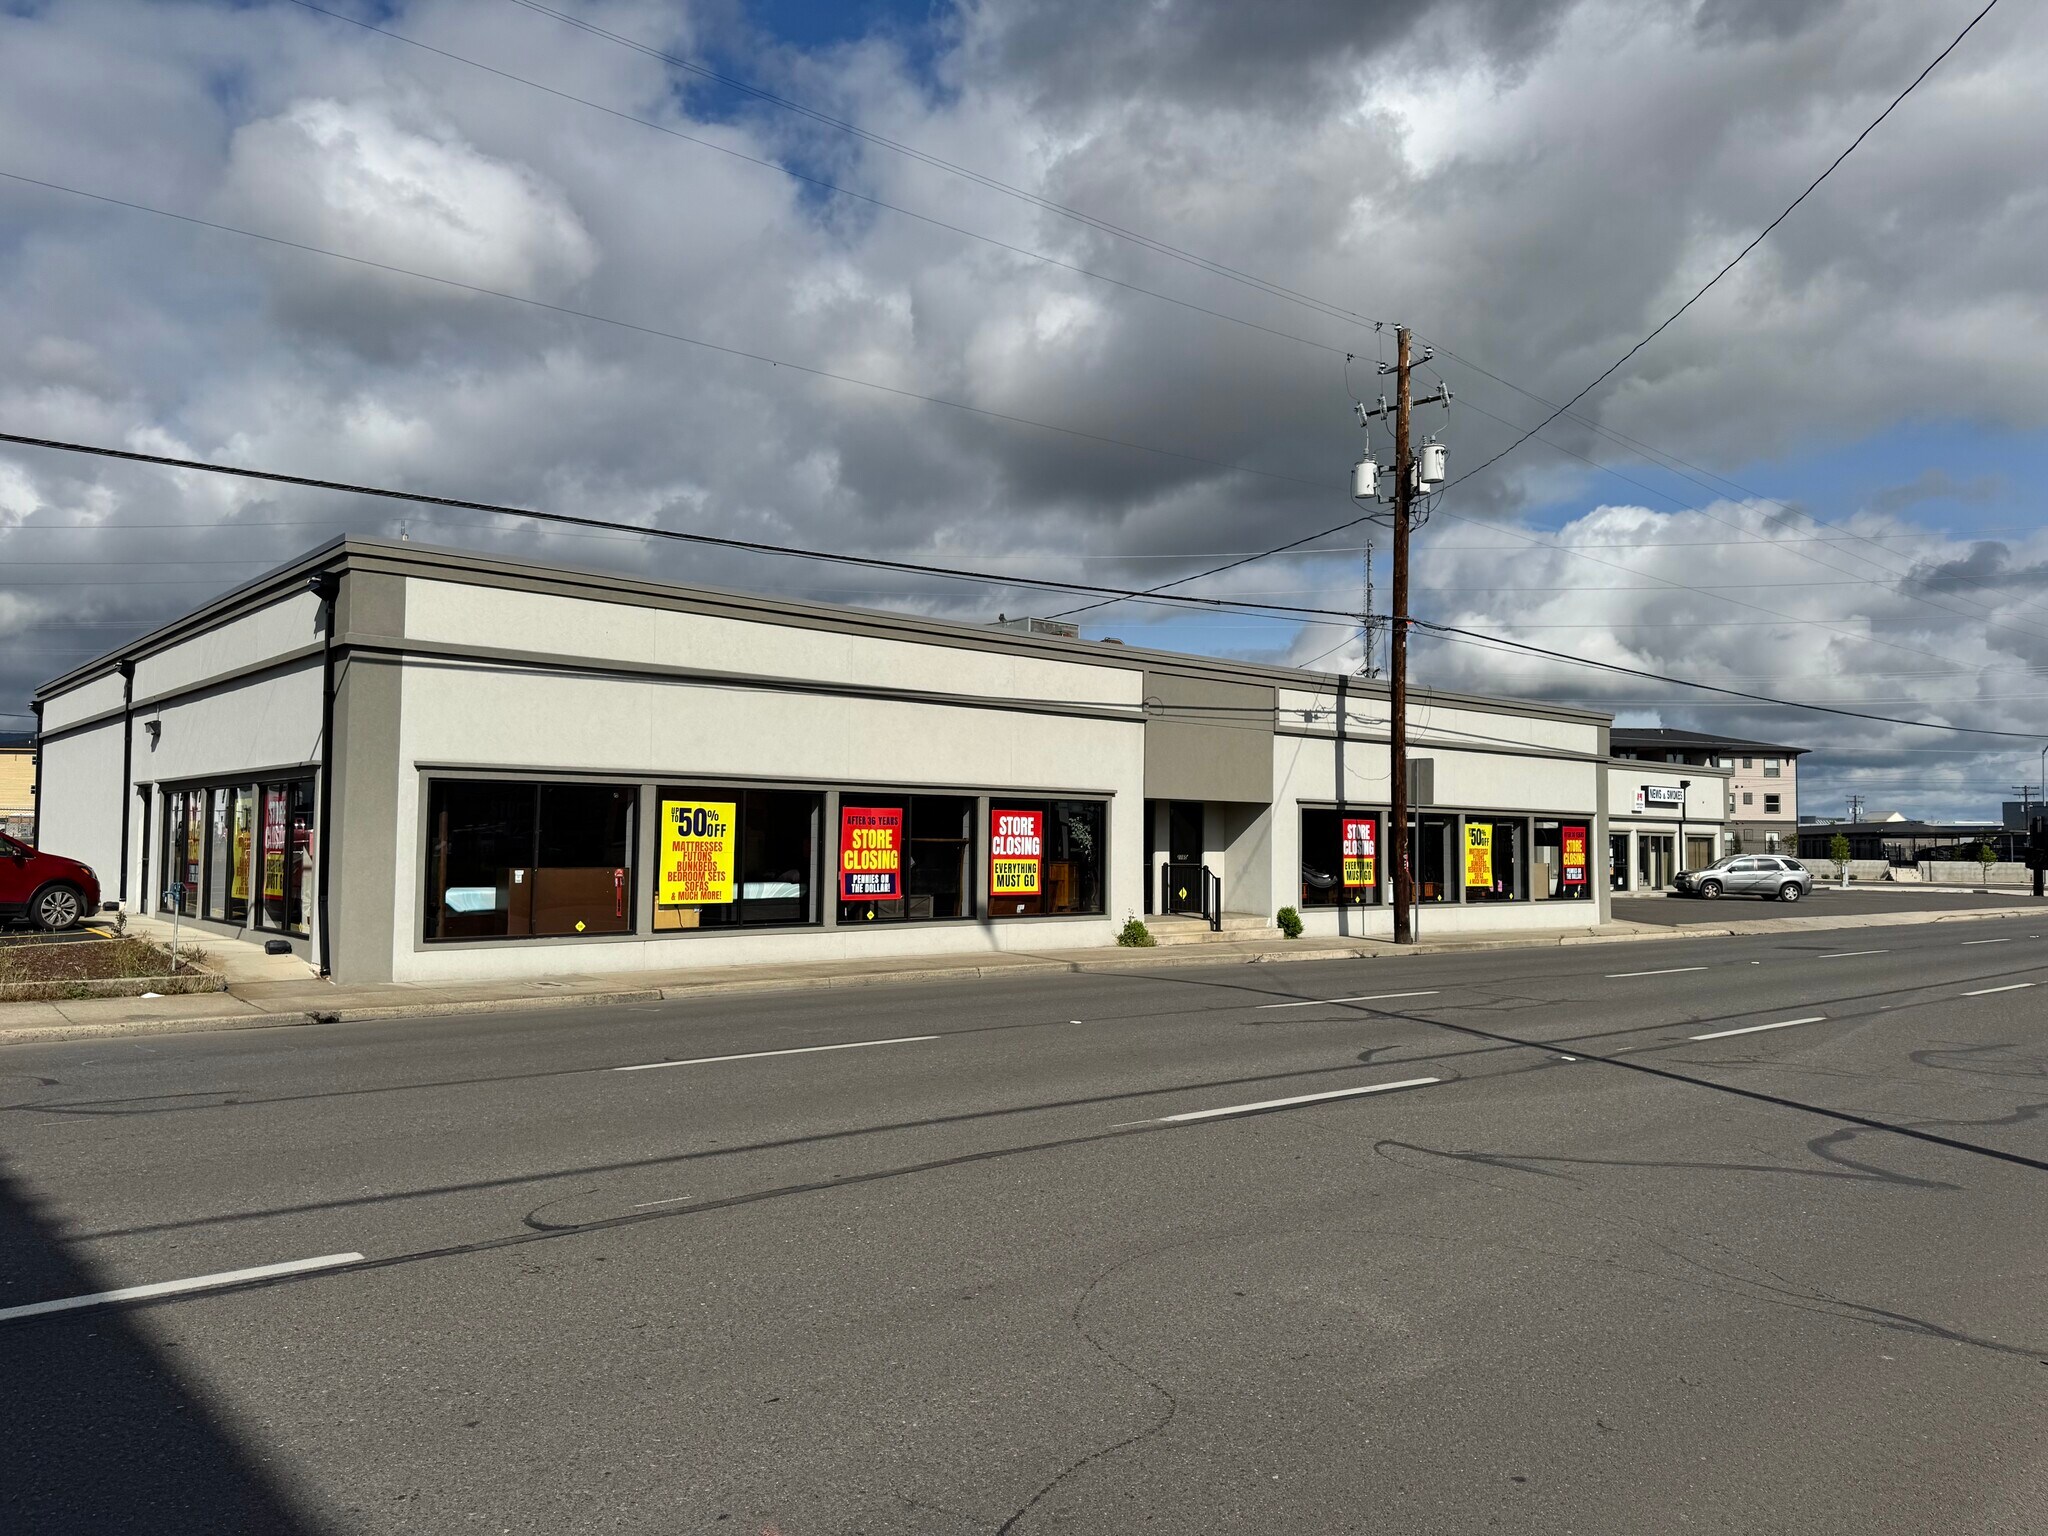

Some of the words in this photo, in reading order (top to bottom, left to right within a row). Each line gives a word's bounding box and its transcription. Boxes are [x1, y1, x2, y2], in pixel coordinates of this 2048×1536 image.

[1650, 789, 1662, 799] NEWS
[1667, 790, 1682, 800] SMOKES
[678, 808, 719, 837] 50%
[847, 816, 866, 825] AFTER
[868, 816, 876, 824] 36
[878, 816, 898, 825] YEARS
[999, 816, 1034, 836] STORE
[707, 824, 726, 837] OFF
[1347, 824, 1370, 839] STORE
[852, 829, 893, 849] STORE
[672, 841, 723, 852] MATTRESSES
[992, 836, 1040, 855] CLOSING
[1344, 840, 1374, 855] CLOSING
[1566, 840, 1582, 852] STORE
[683, 852, 712, 862] FUTONS
[844, 850, 898, 870] CLOSING
[1563, 853, 1585, 865] CLOSING
[677, 861, 717, 871] BUNKBEDS
[995, 863, 1037, 874] EVERYTHING
[1345, 862, 1372, 870] EVERYTHING
[668, 872, 705, 881] BEDROOM
[708, 872, 726, 881] SETS
[853, 874, 879, 883] PENNIES
[880, 874, 889, 883] ON
[996, 875, 1021, 887] MUST
[1024, 875, 1034, 887] GO
[1346, 871, 1362, 880] MUST
[1364, 871, 1371, 880] GO
[685, 881, 709, 891] SOFAS
[851, 884, 863, 893] THE
[678, 891, 698, 900] MUCH
[700, 891, 722, 900] MORE!
